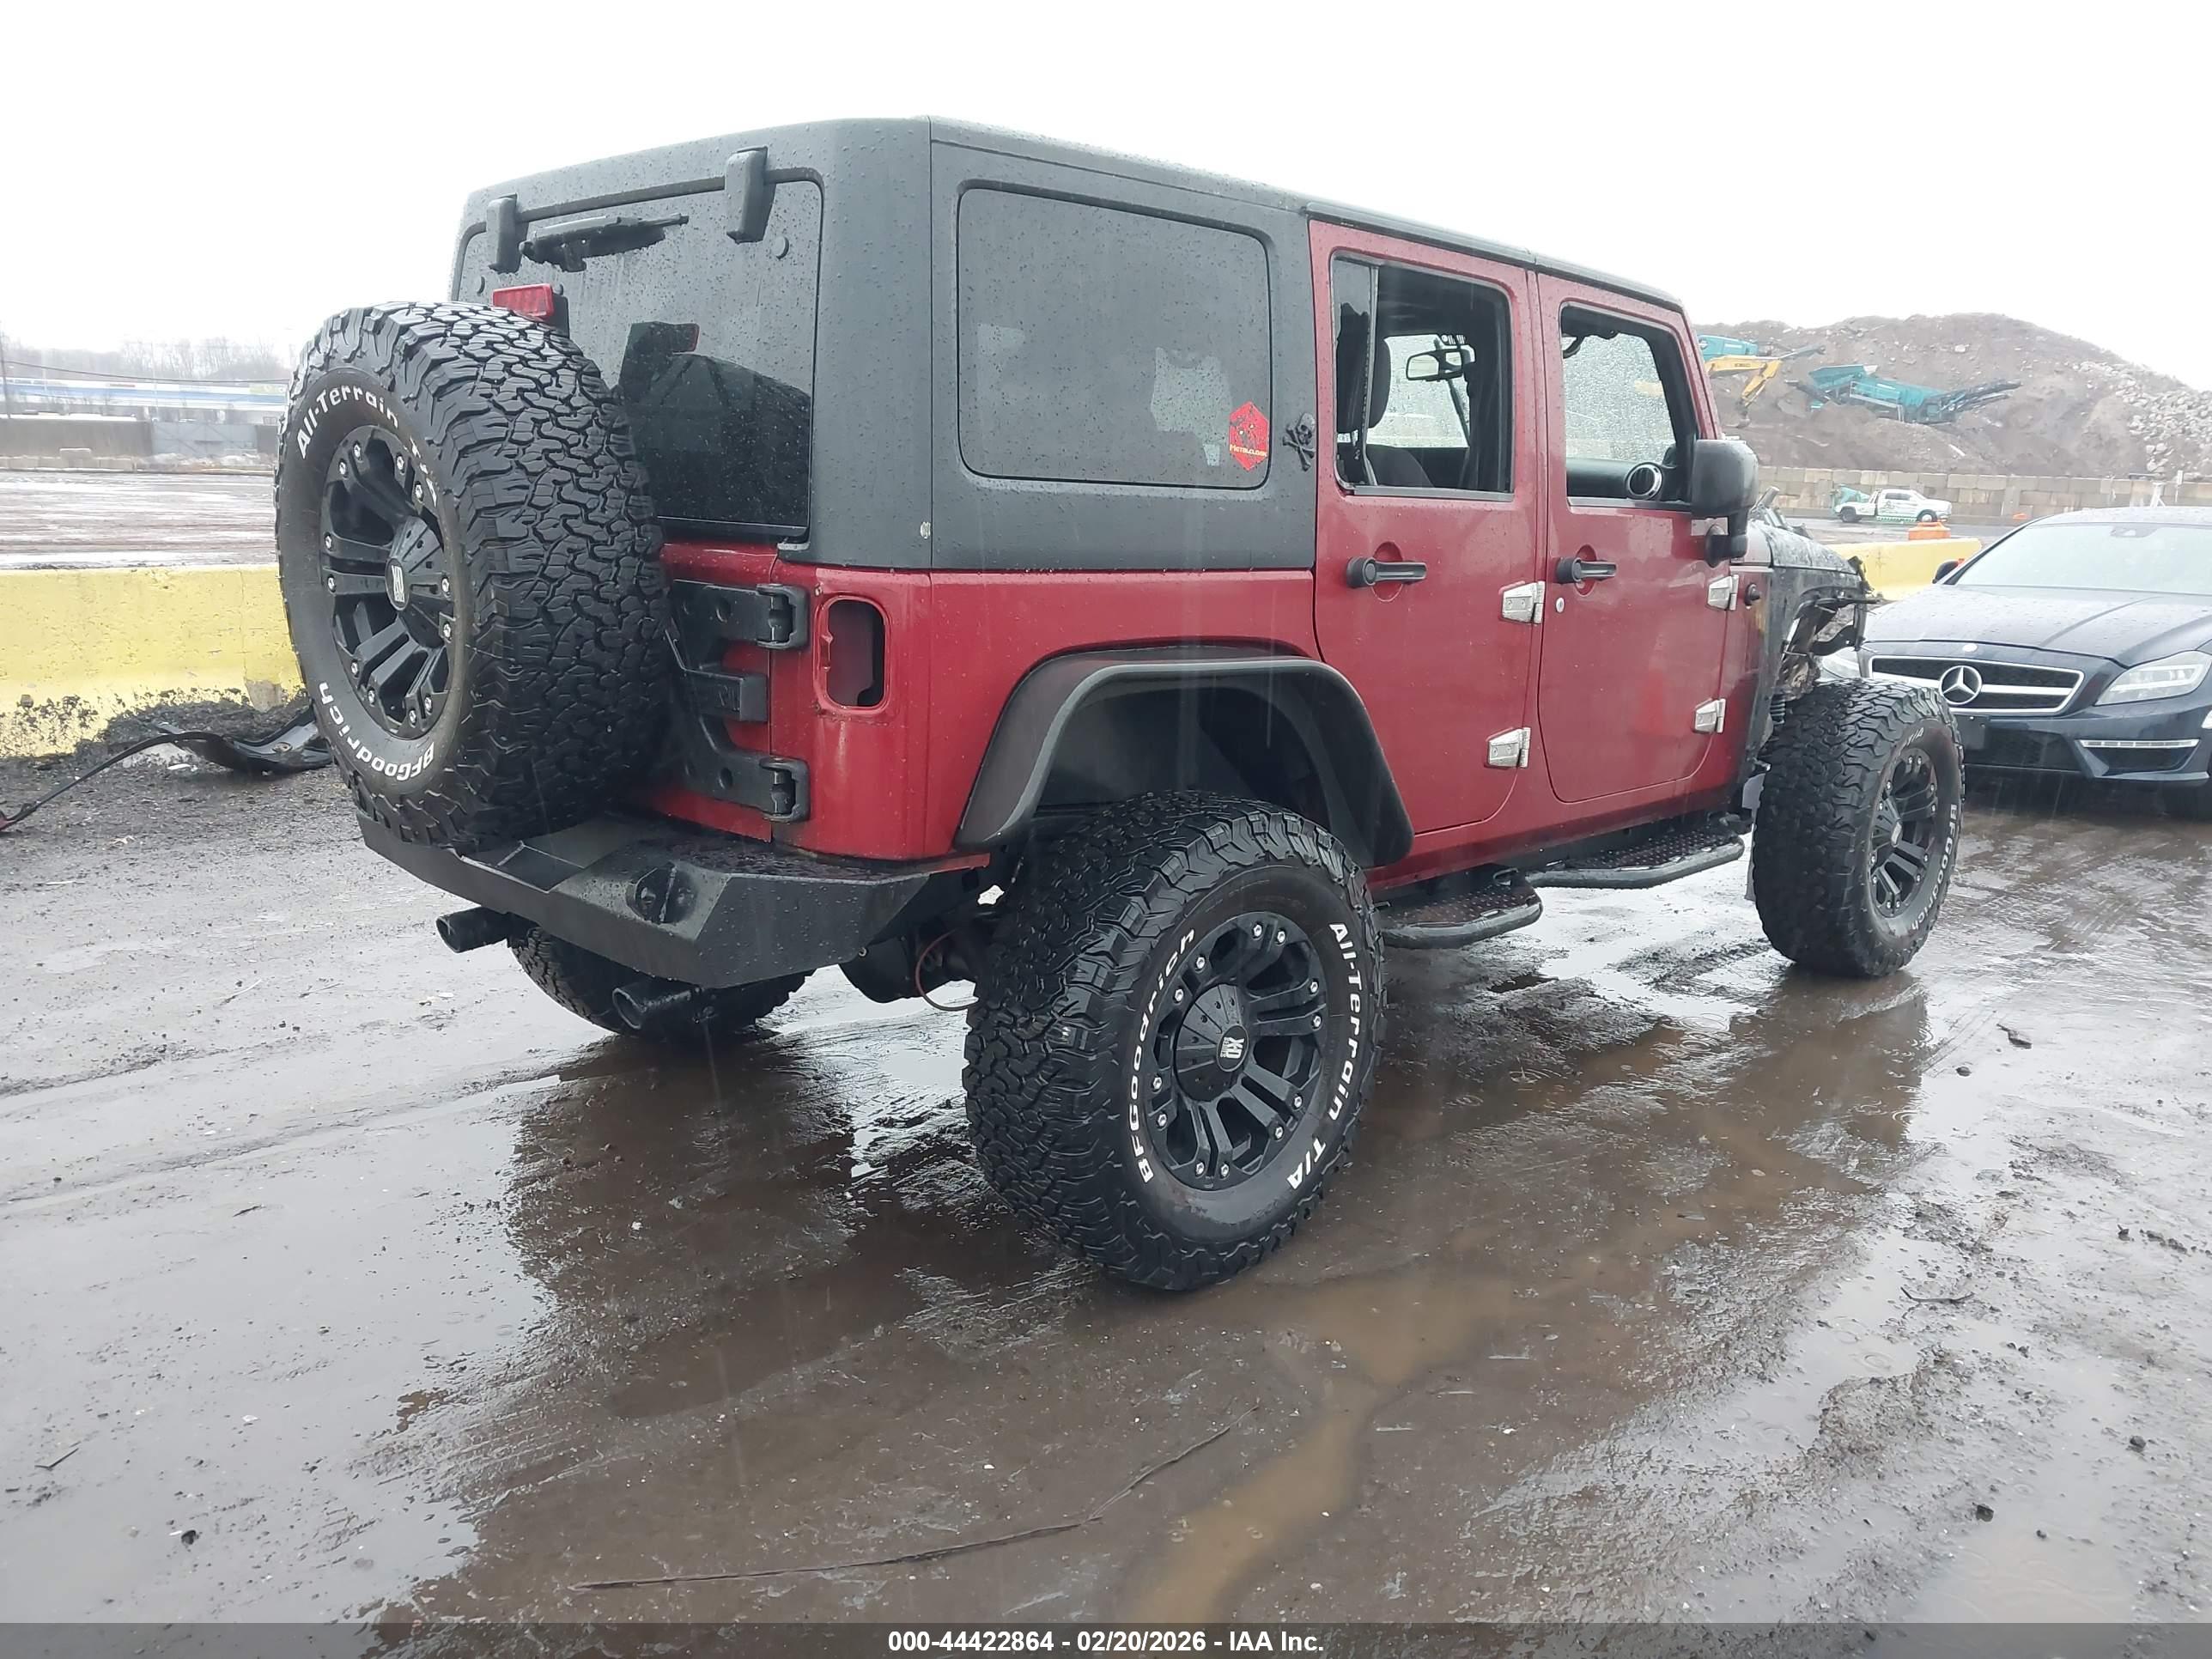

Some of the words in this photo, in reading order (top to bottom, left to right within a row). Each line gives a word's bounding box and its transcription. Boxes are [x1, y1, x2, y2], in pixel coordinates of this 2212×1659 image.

[296, 385, 398, 459] All-Terrain
[319, 682, 434, 781] BFGoodrich
[1911, 803, 1958, 930] BFGoodrich
[1128, 928, 1195, 1183] BFGoodrich
[1328, 922, 1364, 1121] All-Terrain
[1287, 1137, 1327, 1189] T/A
